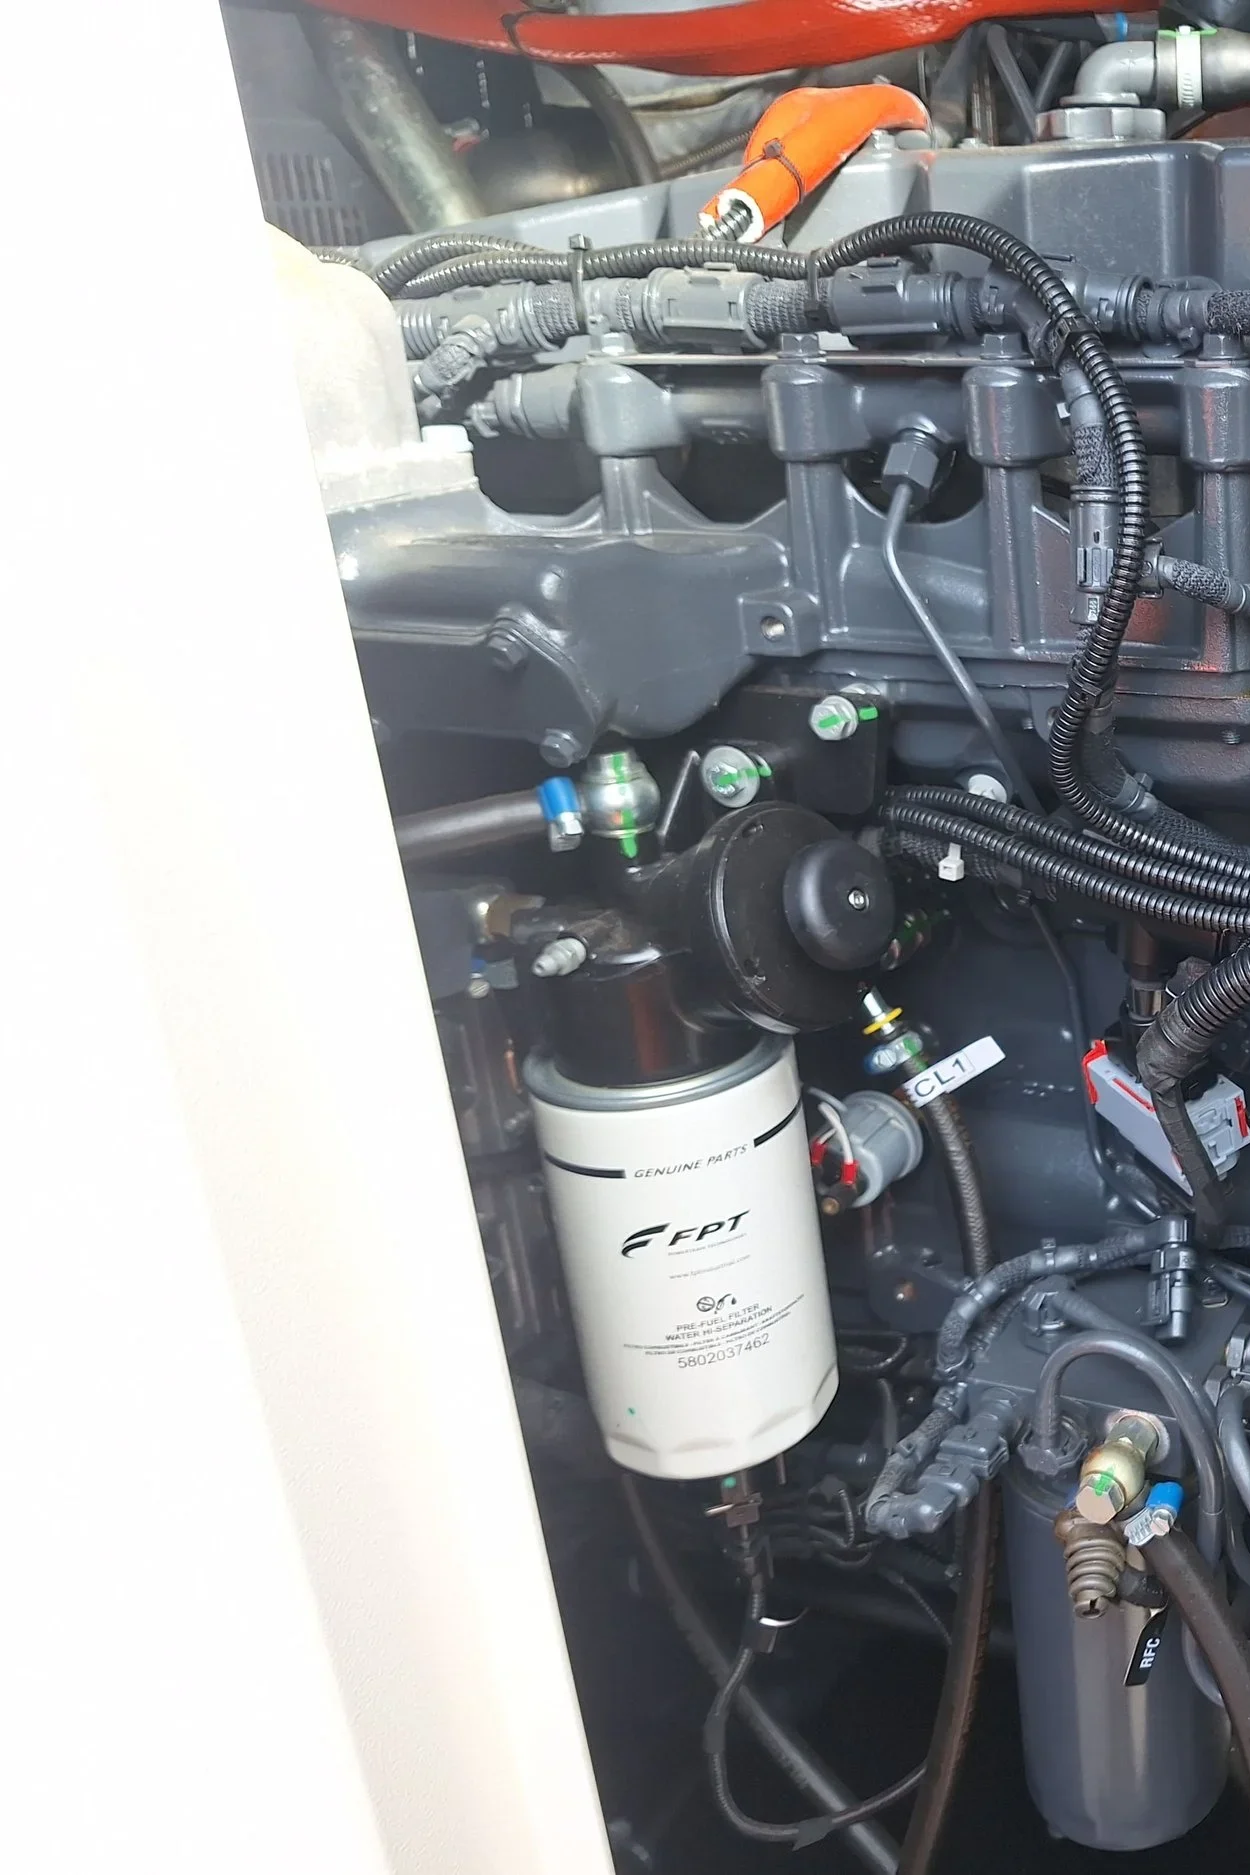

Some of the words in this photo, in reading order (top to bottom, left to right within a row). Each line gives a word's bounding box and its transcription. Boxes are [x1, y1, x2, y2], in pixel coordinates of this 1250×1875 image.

[914, 1058, 965, 1097] CL1
[634, 1158, 703, 1178] GENUINE
[706, 1144, 748, 1167] PARTS
[667, 1209, 751, 1247] FPT
[675, 1318, 726, 1332] PRE-FUEL
[728, 1302, 760, 1321] FILTER
[665, 1329, 700, 1342] WATER
[678, 1332, 770, 1369] 5802037462
[1139, 1637, 1160, 1669] RFC
